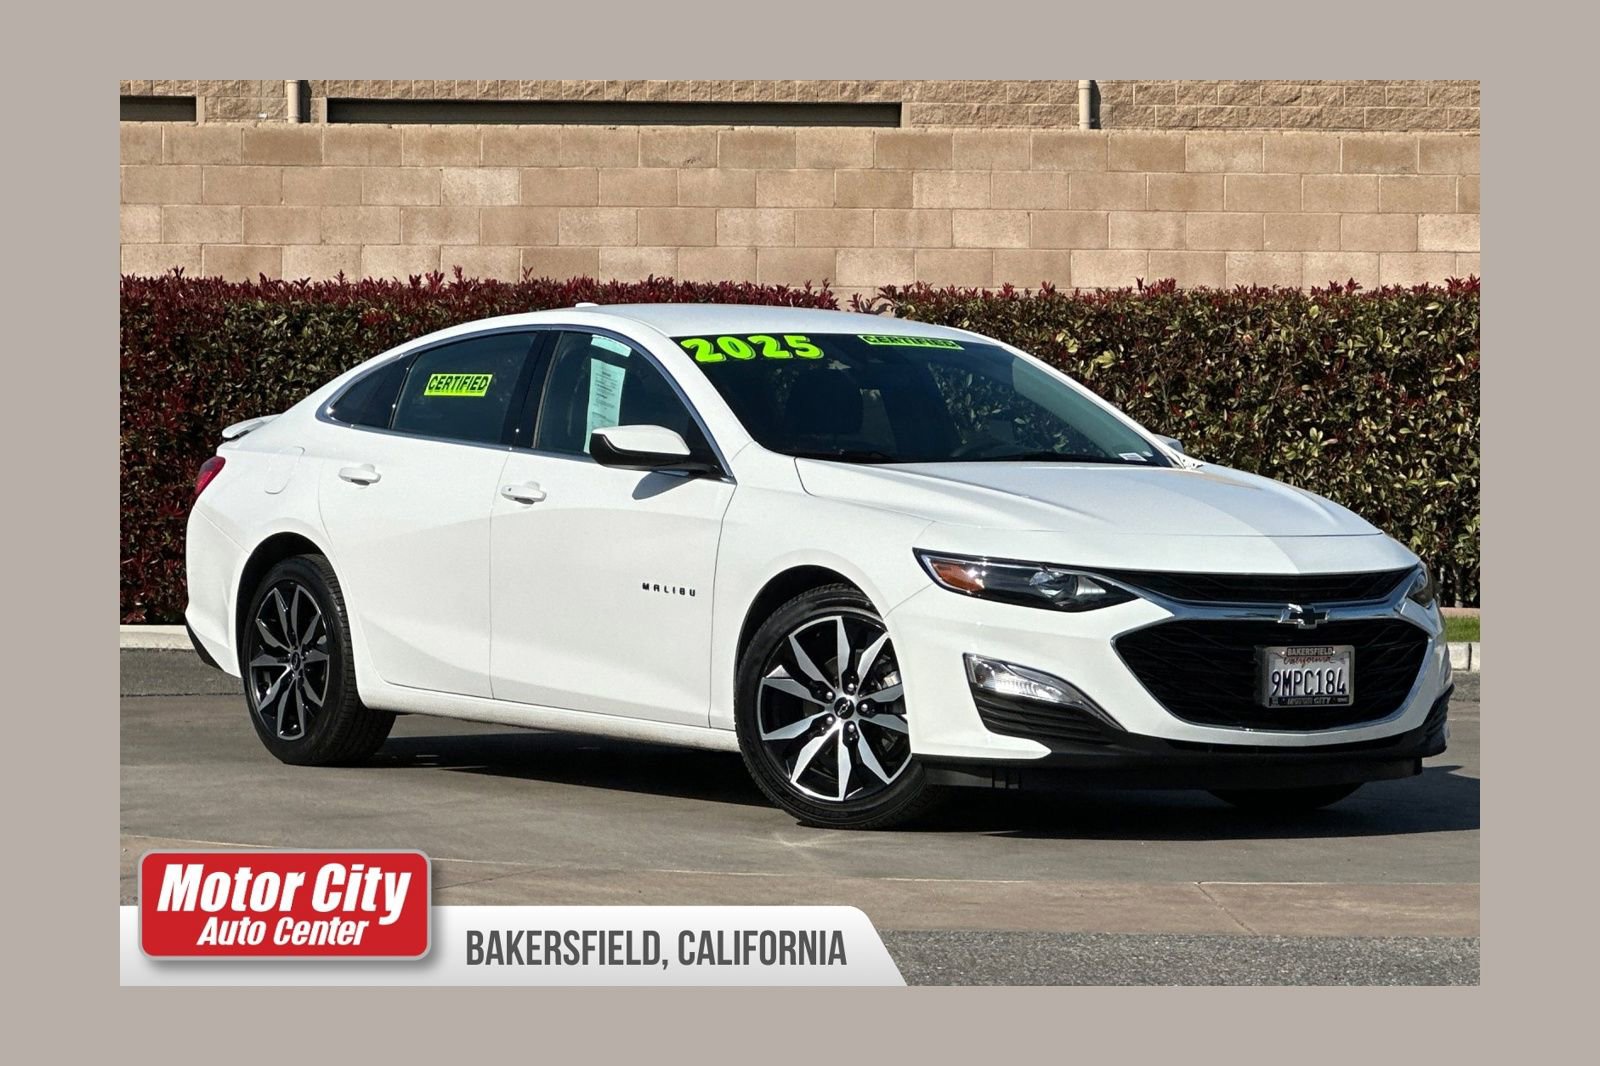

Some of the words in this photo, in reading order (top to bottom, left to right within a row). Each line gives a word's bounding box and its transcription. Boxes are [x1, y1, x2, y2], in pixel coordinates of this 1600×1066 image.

[680, 334, 824, 362] 2025
[428, 375, 489, 391] CERTIFIED
[642, 582, 696, 597] MALIBU
[1287, 647, 1333, 656] BAKERSFIELD
[1271, 669, 1346, 696] 9MPC184
